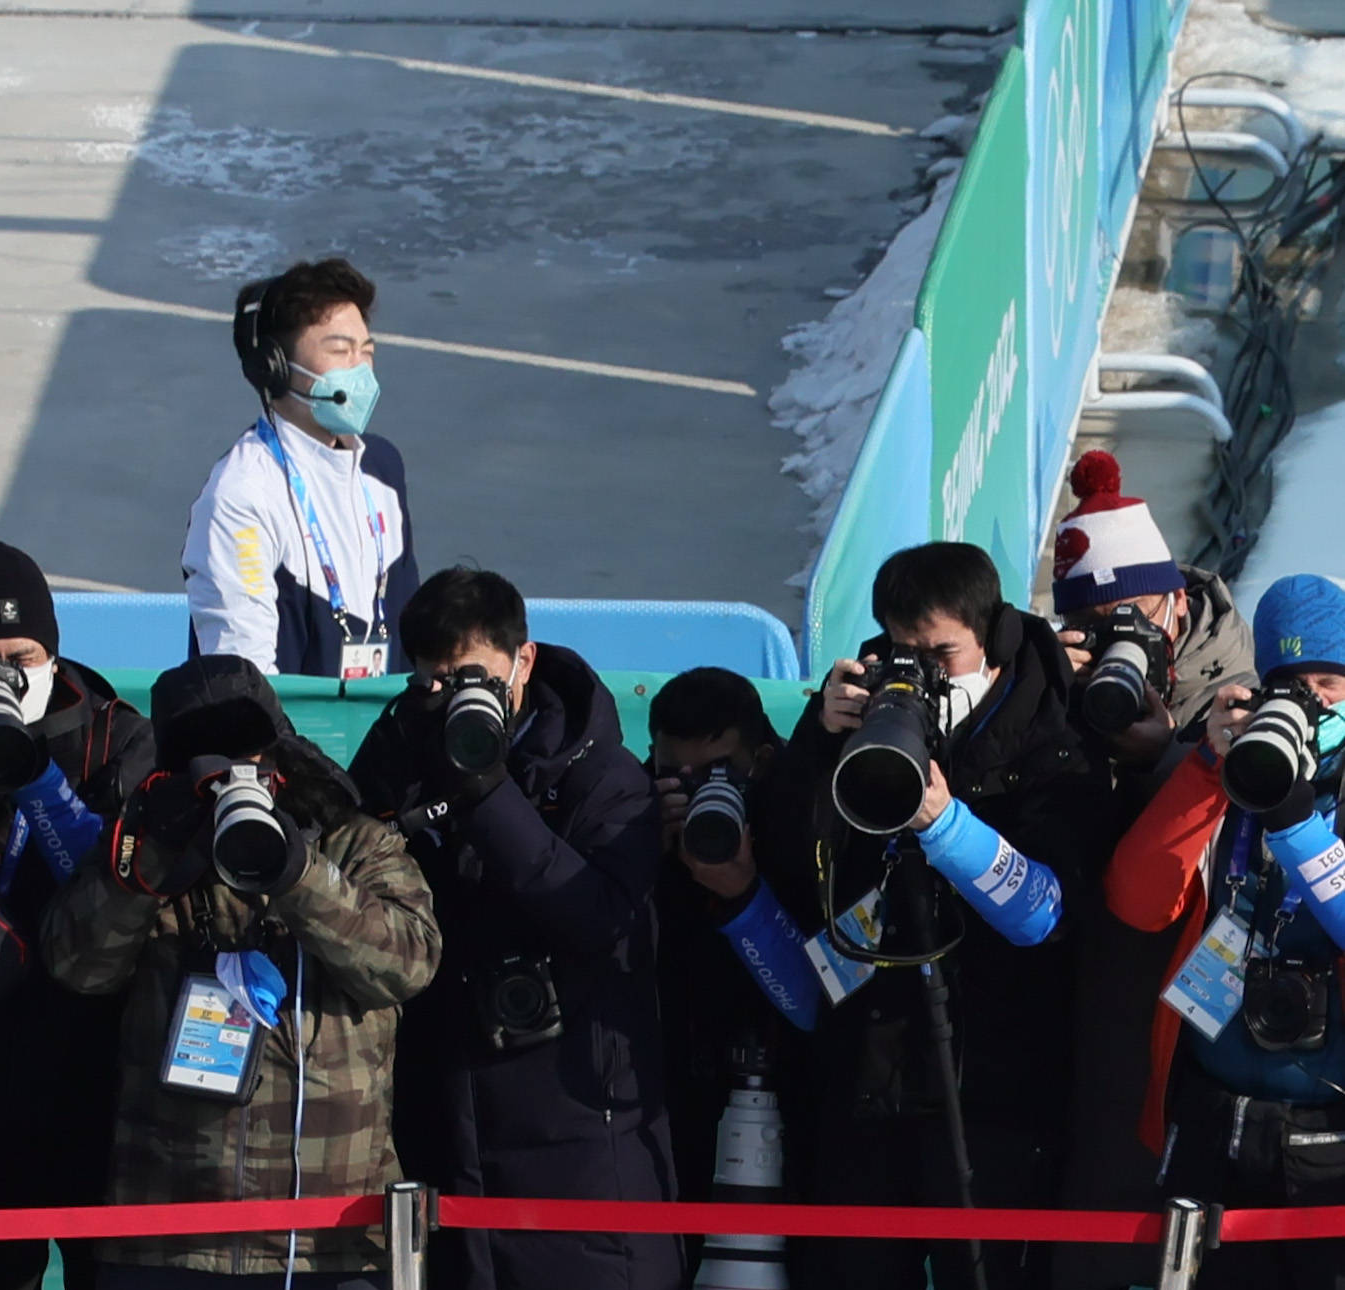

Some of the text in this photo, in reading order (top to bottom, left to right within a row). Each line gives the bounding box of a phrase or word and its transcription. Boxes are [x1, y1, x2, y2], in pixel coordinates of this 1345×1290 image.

[986, 298, 1019, 457] 2022
[54, 849, 78, 875] FO
[992, 844, 1012, 877] 008
[1319, 846, 1344, 868] 031
[741, 936, 766, 967] FOP
[757, 964, 799, 1012] PHOTO
